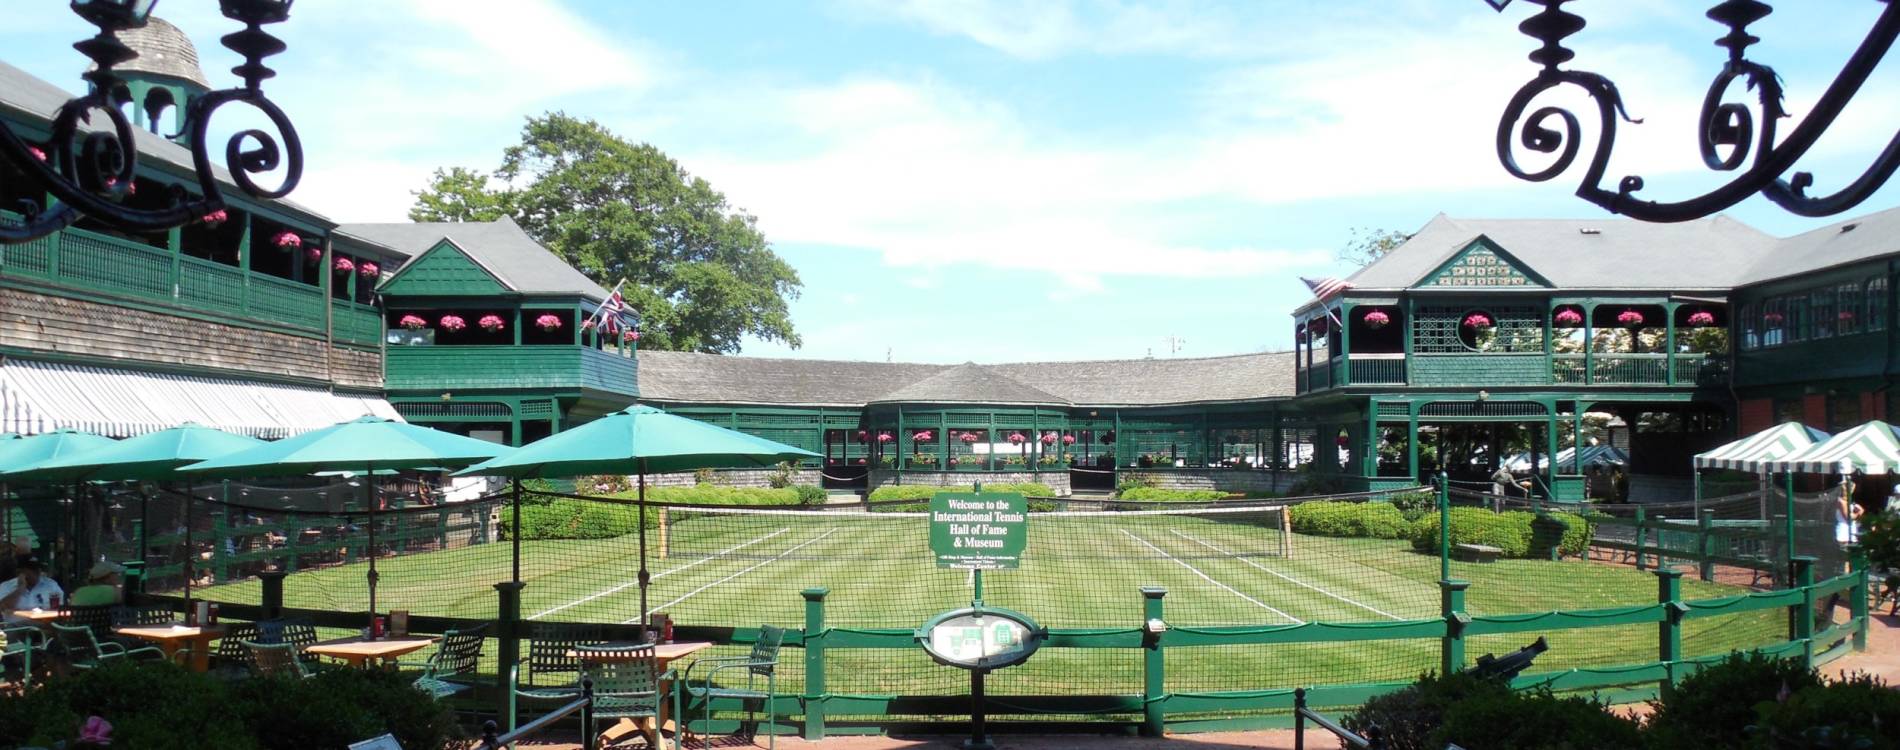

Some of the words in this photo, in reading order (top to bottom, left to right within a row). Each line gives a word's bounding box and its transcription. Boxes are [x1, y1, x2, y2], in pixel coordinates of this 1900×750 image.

[948, 499, 984, 510] Welcome
[986, 500, 994, 510] to
[996, 500, 1009, 510] the
[934, 511, 992, 522] International
[994, 511, 1024, 522] Tennis
[949, 524, 969, 535] Hall
[970, 524, 980, 535] of
[982, 524, 1008, 535] Fame
[953, 537, 962, 548] &
[964, 537, 1004, 548] Museum
